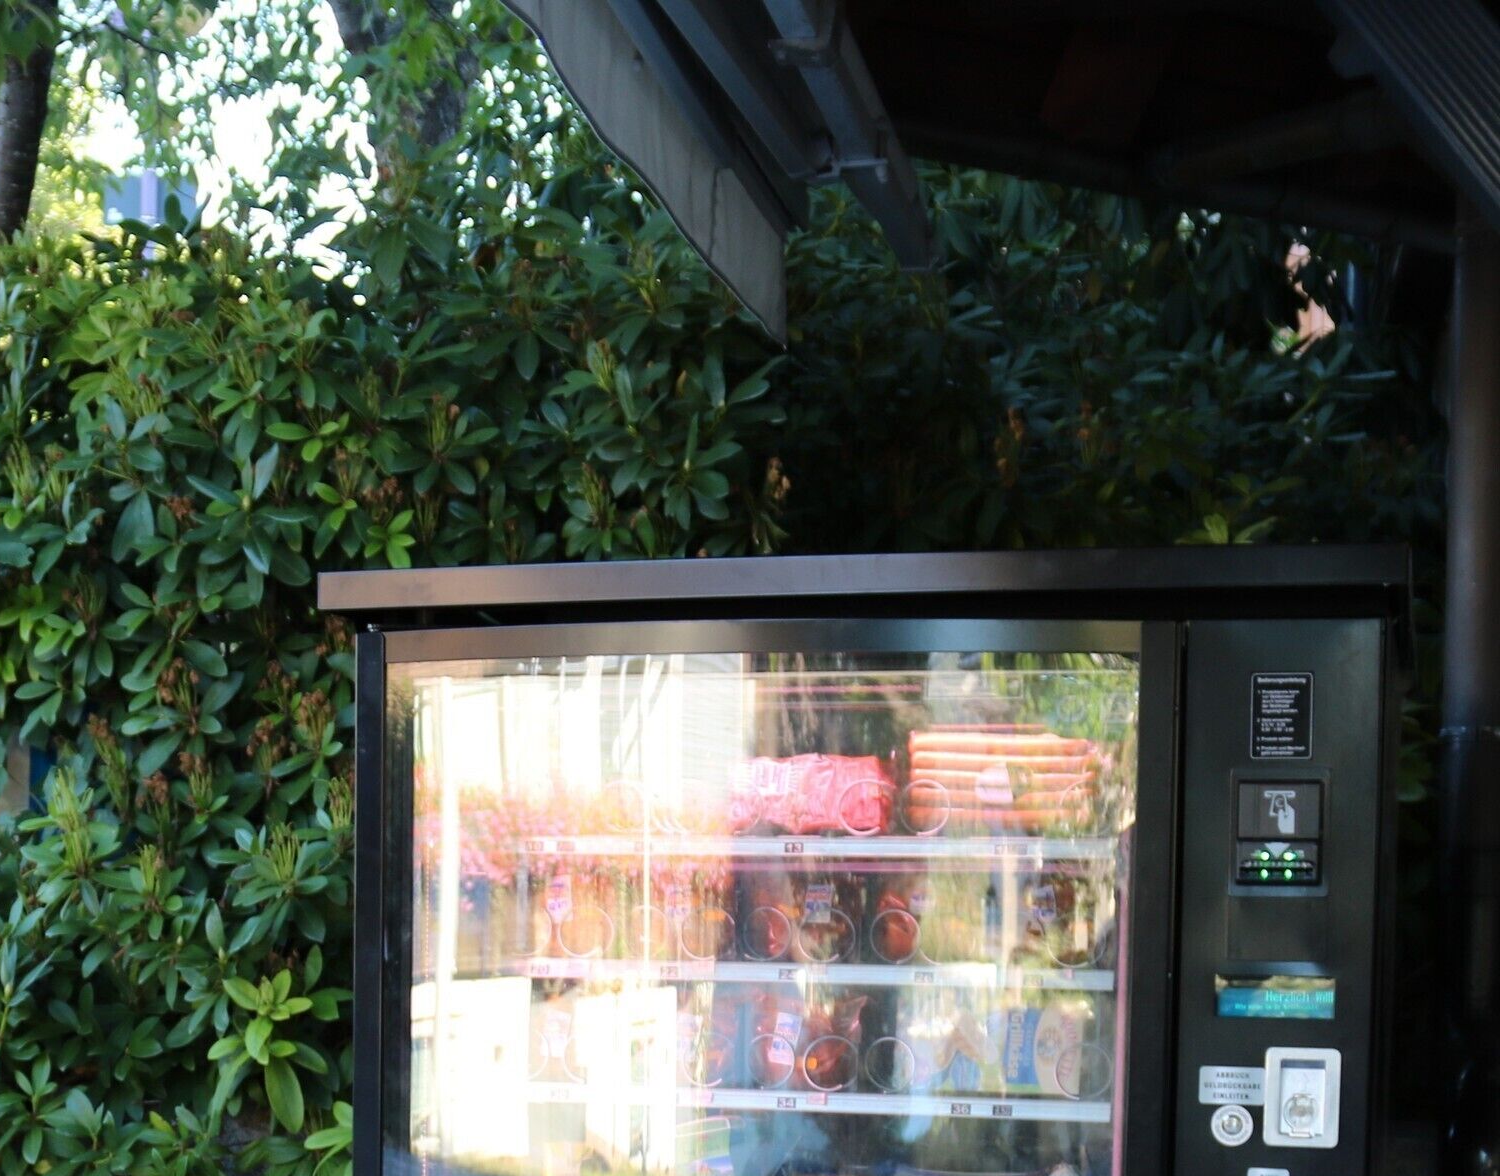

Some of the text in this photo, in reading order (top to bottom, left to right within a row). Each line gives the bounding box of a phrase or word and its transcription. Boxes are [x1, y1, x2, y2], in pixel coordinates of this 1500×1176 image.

[1266, 990, 1309, 1002] Herzlich
[778, 1097, 795, 1108] 34
[952, 1104, 970, 1115] 36
